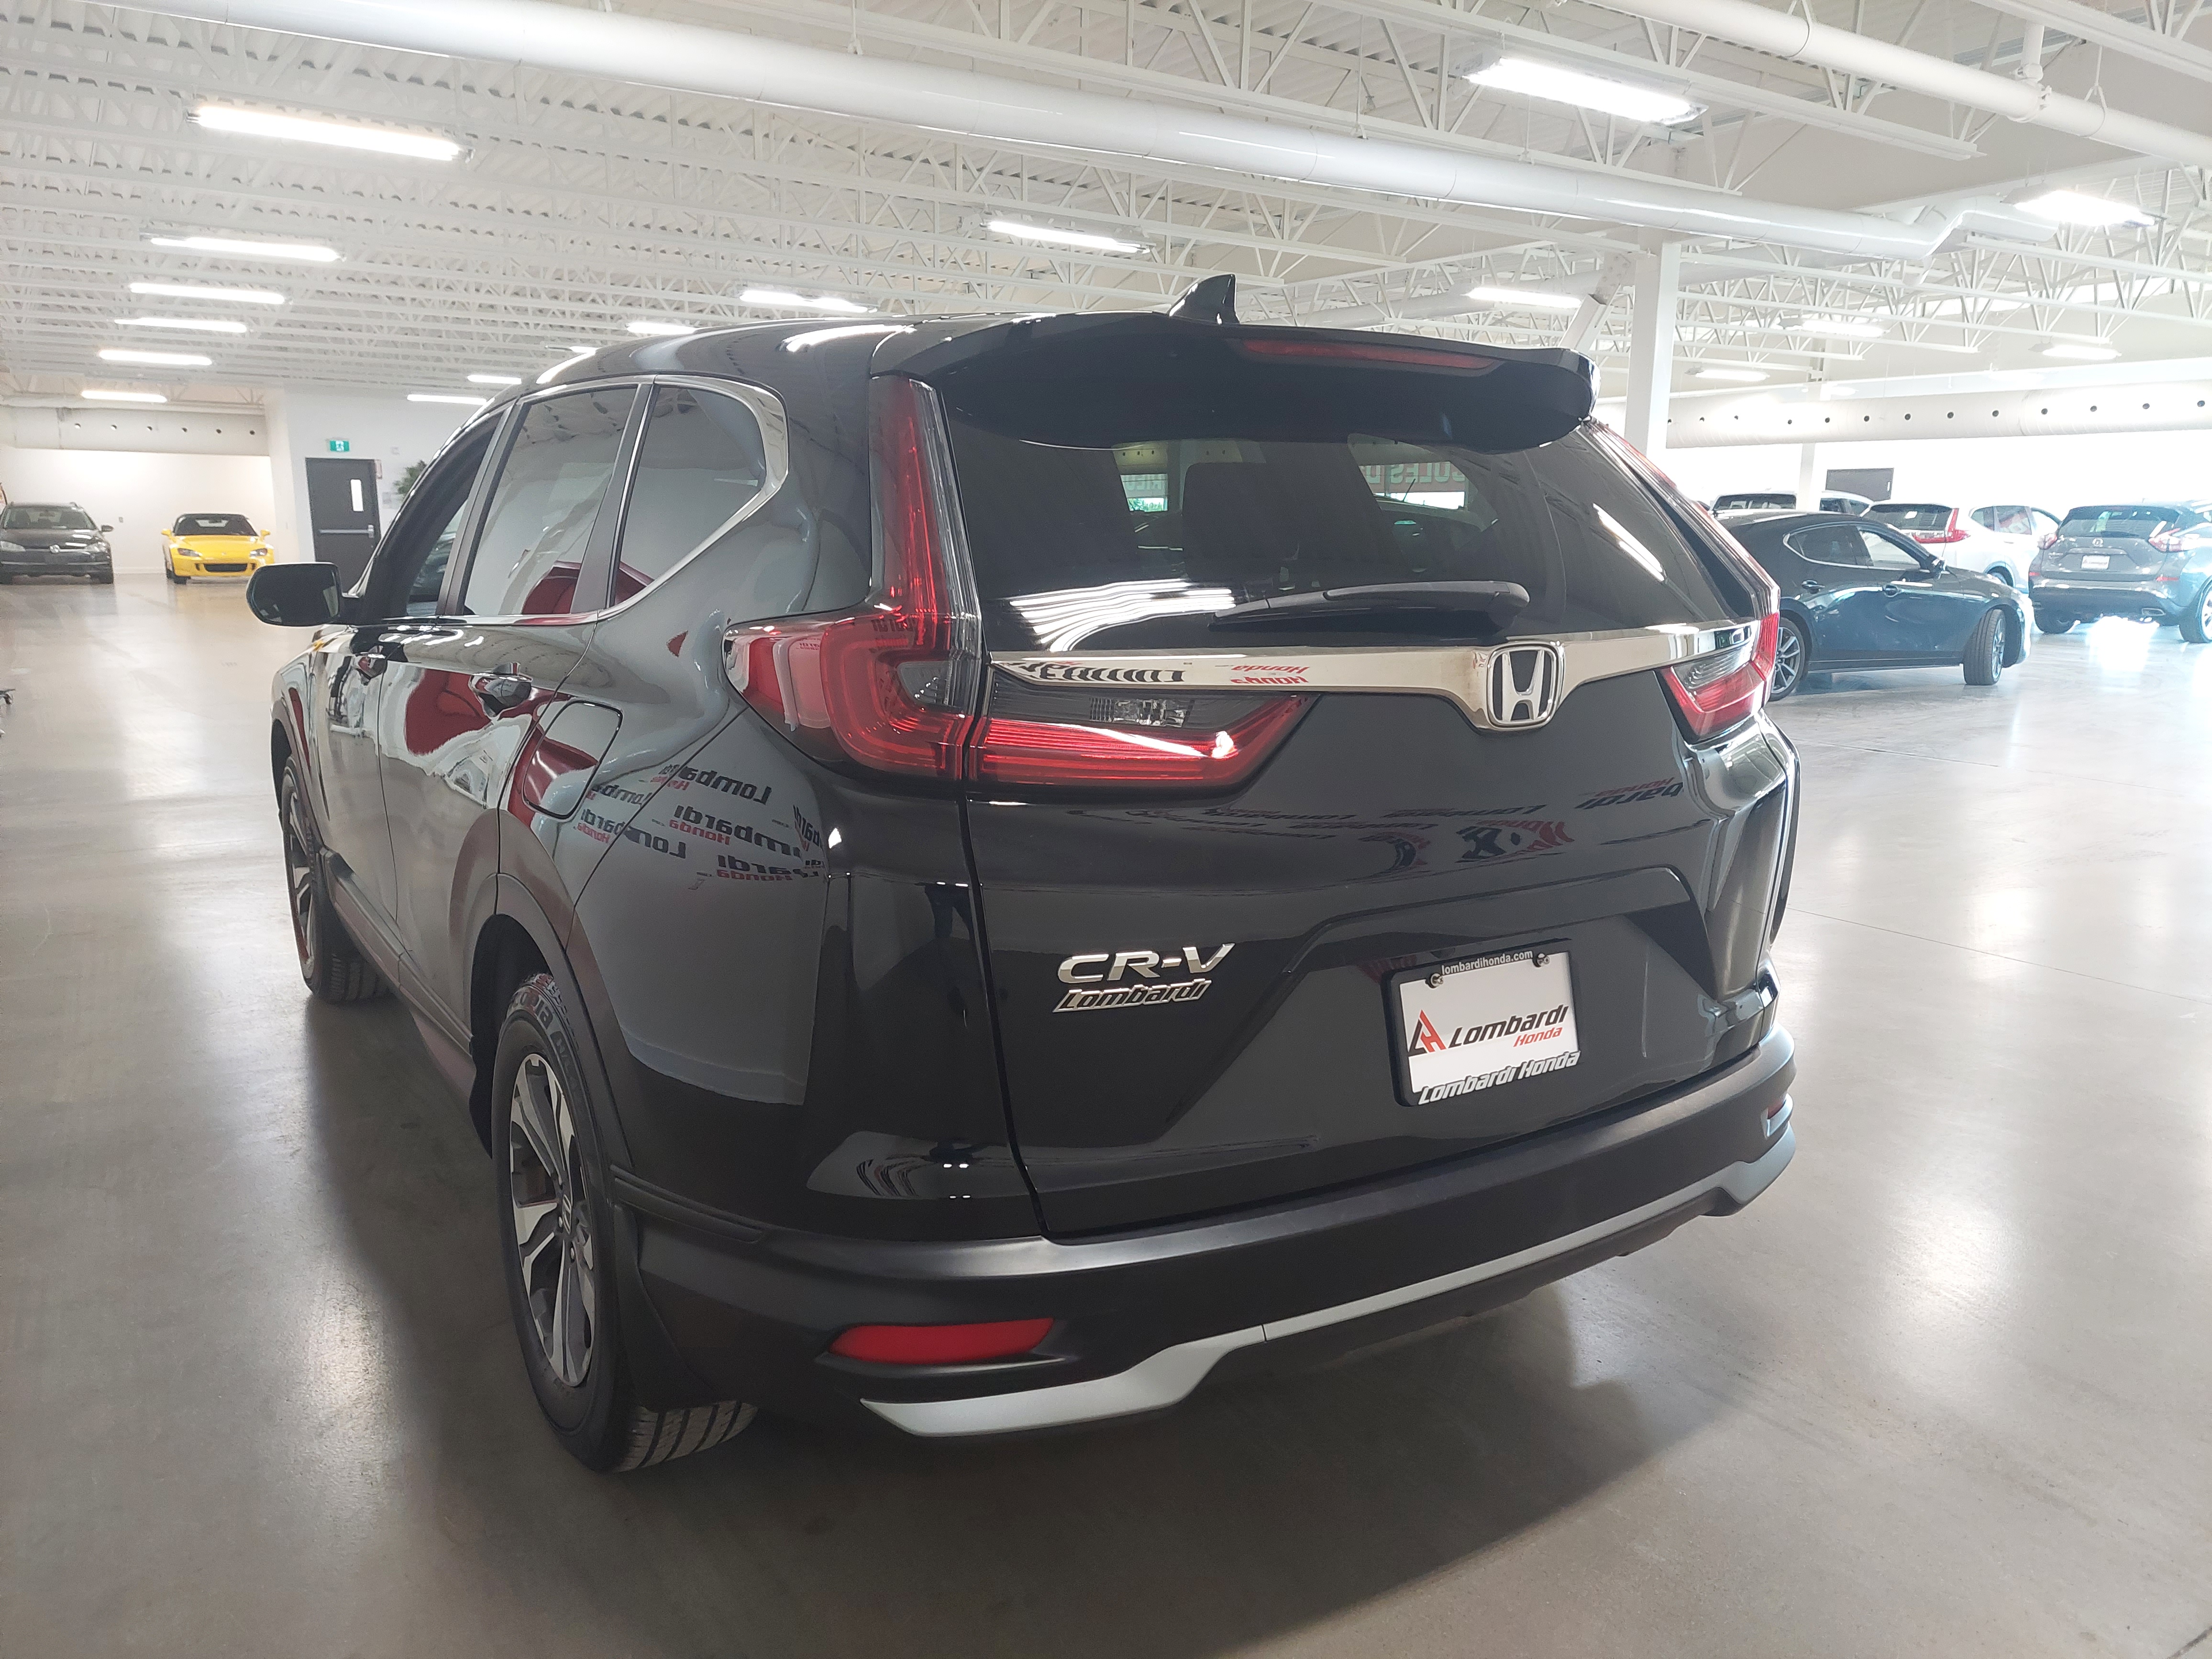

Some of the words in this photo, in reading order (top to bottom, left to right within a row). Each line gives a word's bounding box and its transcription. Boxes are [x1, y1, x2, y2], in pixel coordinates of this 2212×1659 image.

[1057, 942, 1236, 984] CR-V
[1441, 951, 1533, 975] lombardihonda.com
[1052, 978, 1212, 1013] Lombardi
[1448, 1004, 1569, 1049] Lombardi
[1513, 1027, 1563, 1048] Honda
[1418, 1066, 1517, 1106] Lombardi
[1517, 1051, 1581, 1081] Honda
